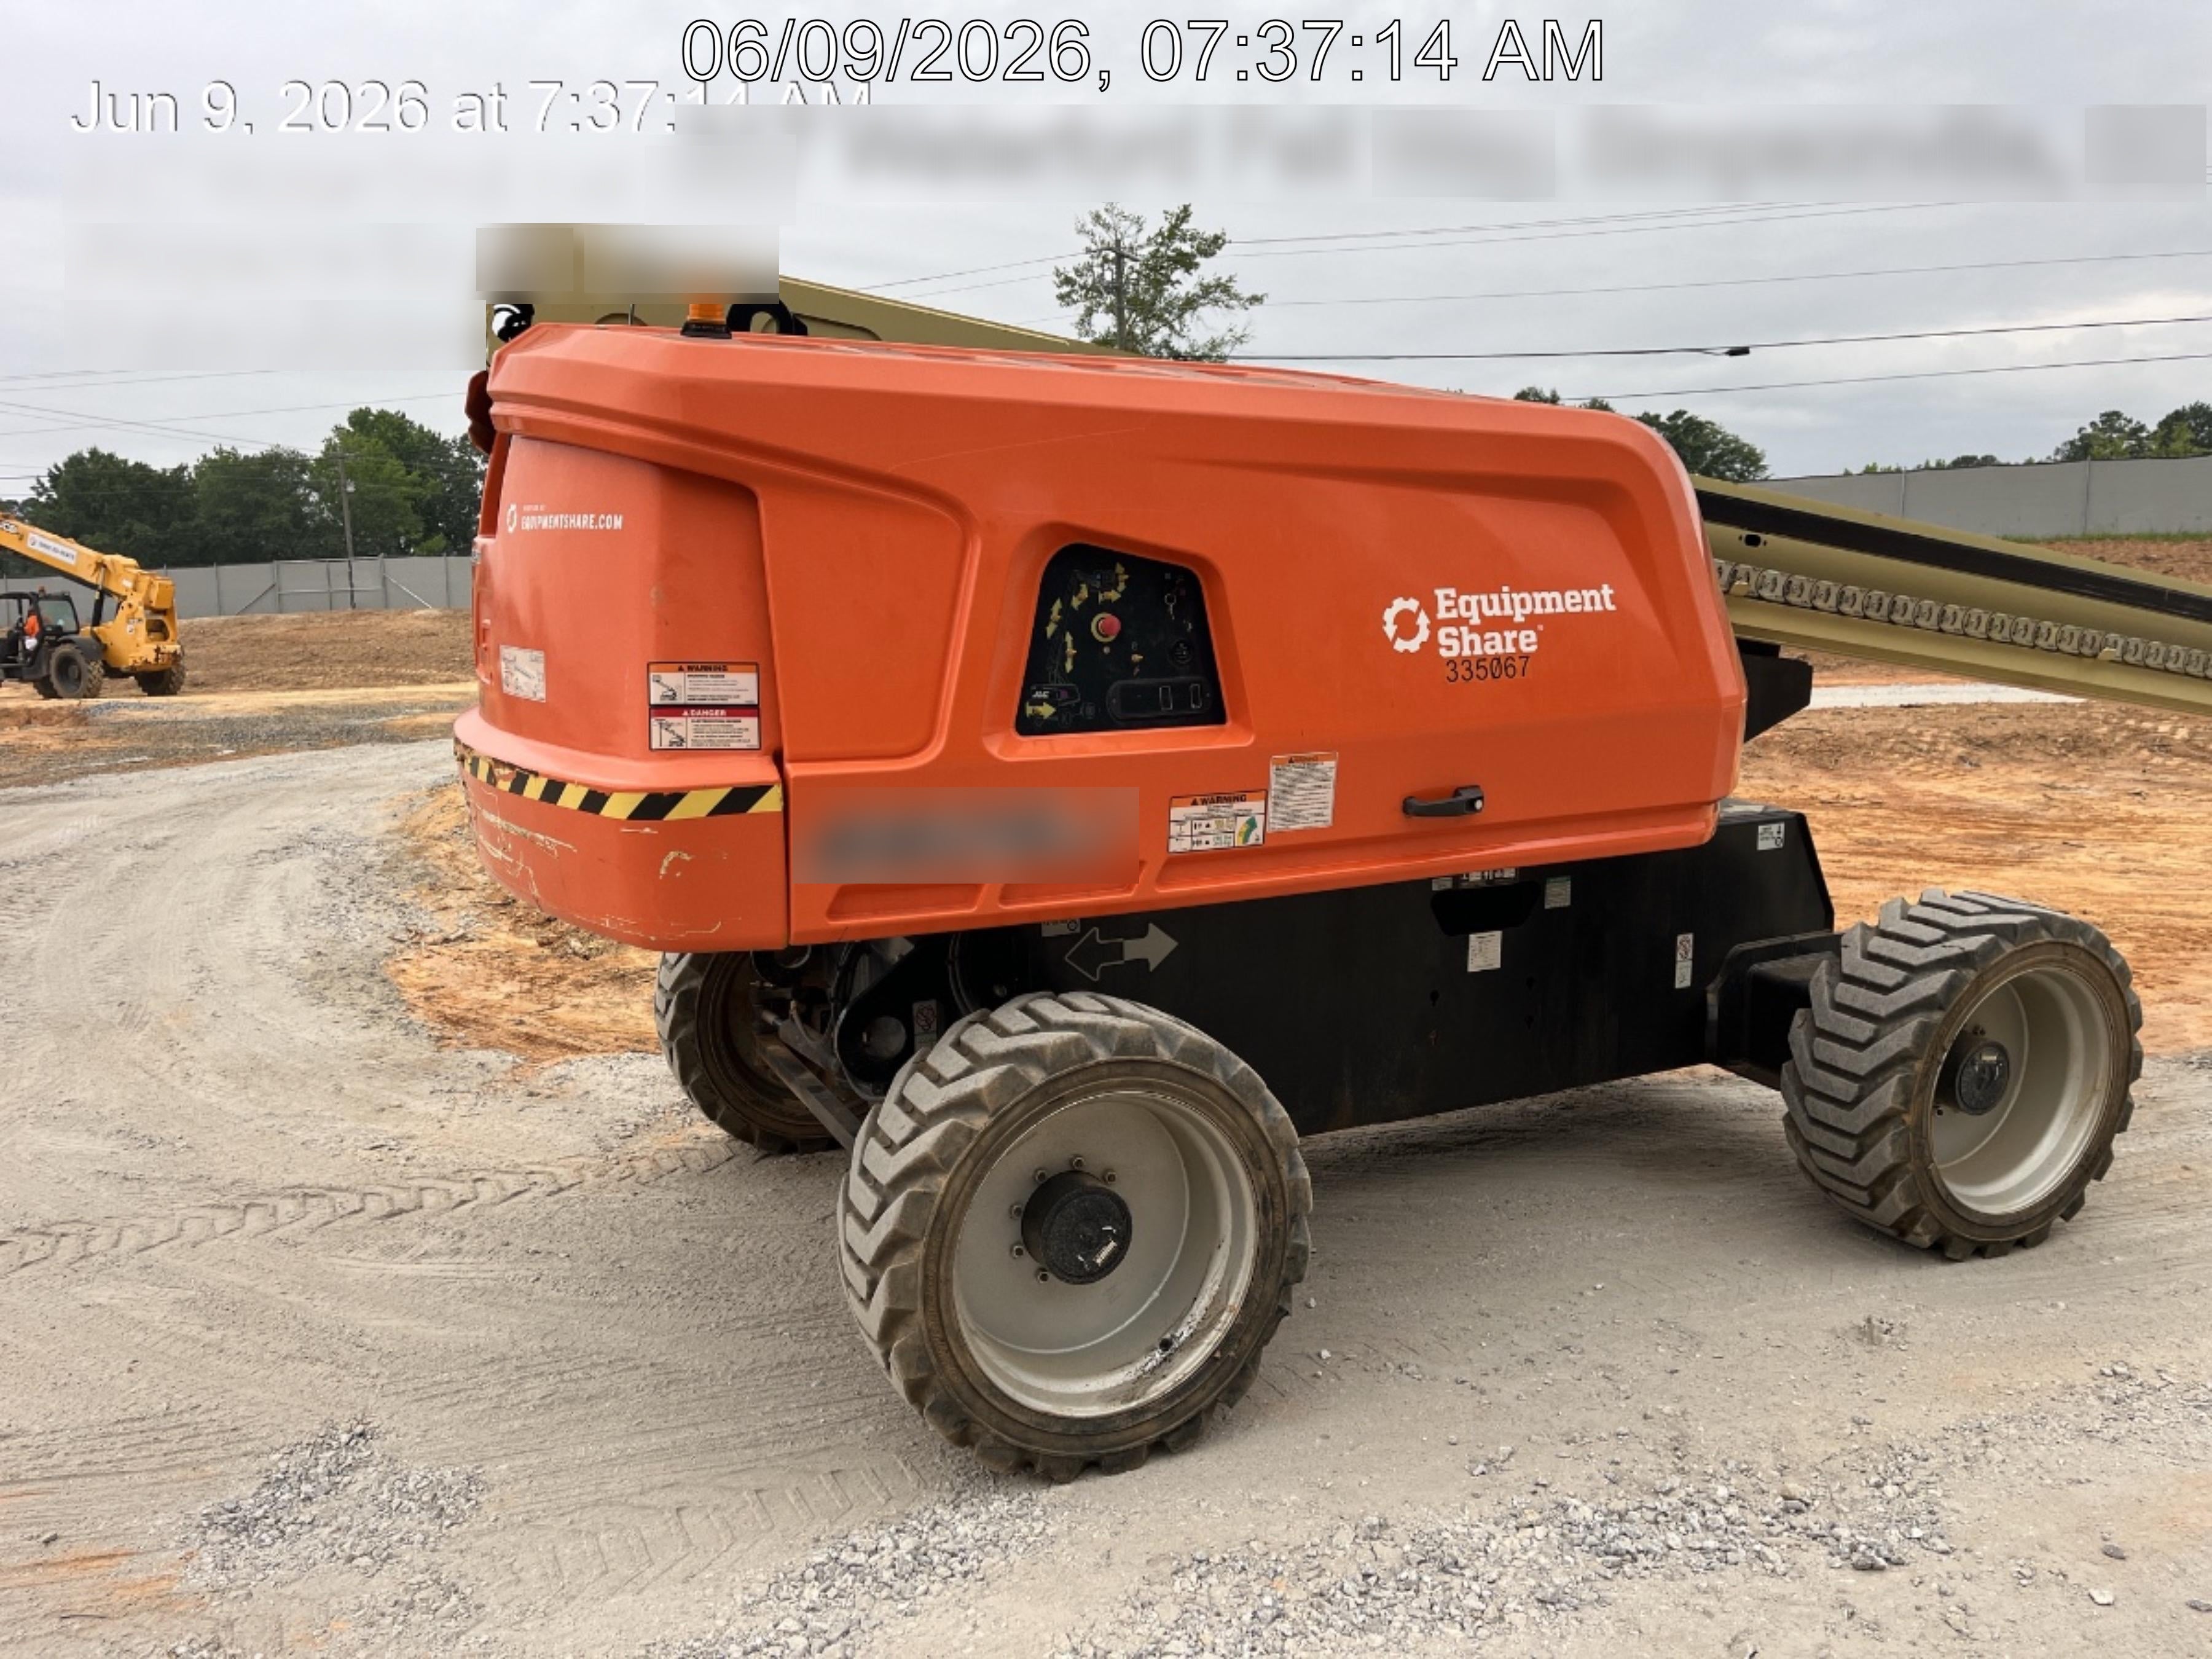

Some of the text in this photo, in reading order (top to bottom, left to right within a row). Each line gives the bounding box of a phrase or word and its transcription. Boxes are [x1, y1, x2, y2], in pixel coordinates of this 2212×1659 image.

[521, 513, 623, 531] EQUIPMENTSHARE.COM
[1434, 584, 1617, 626] Equipment
[1437, 626, 1539, 657] Share
[1445, 656, 1531, 683] 335067
[1199, 794, 1247, 806] WARNING
